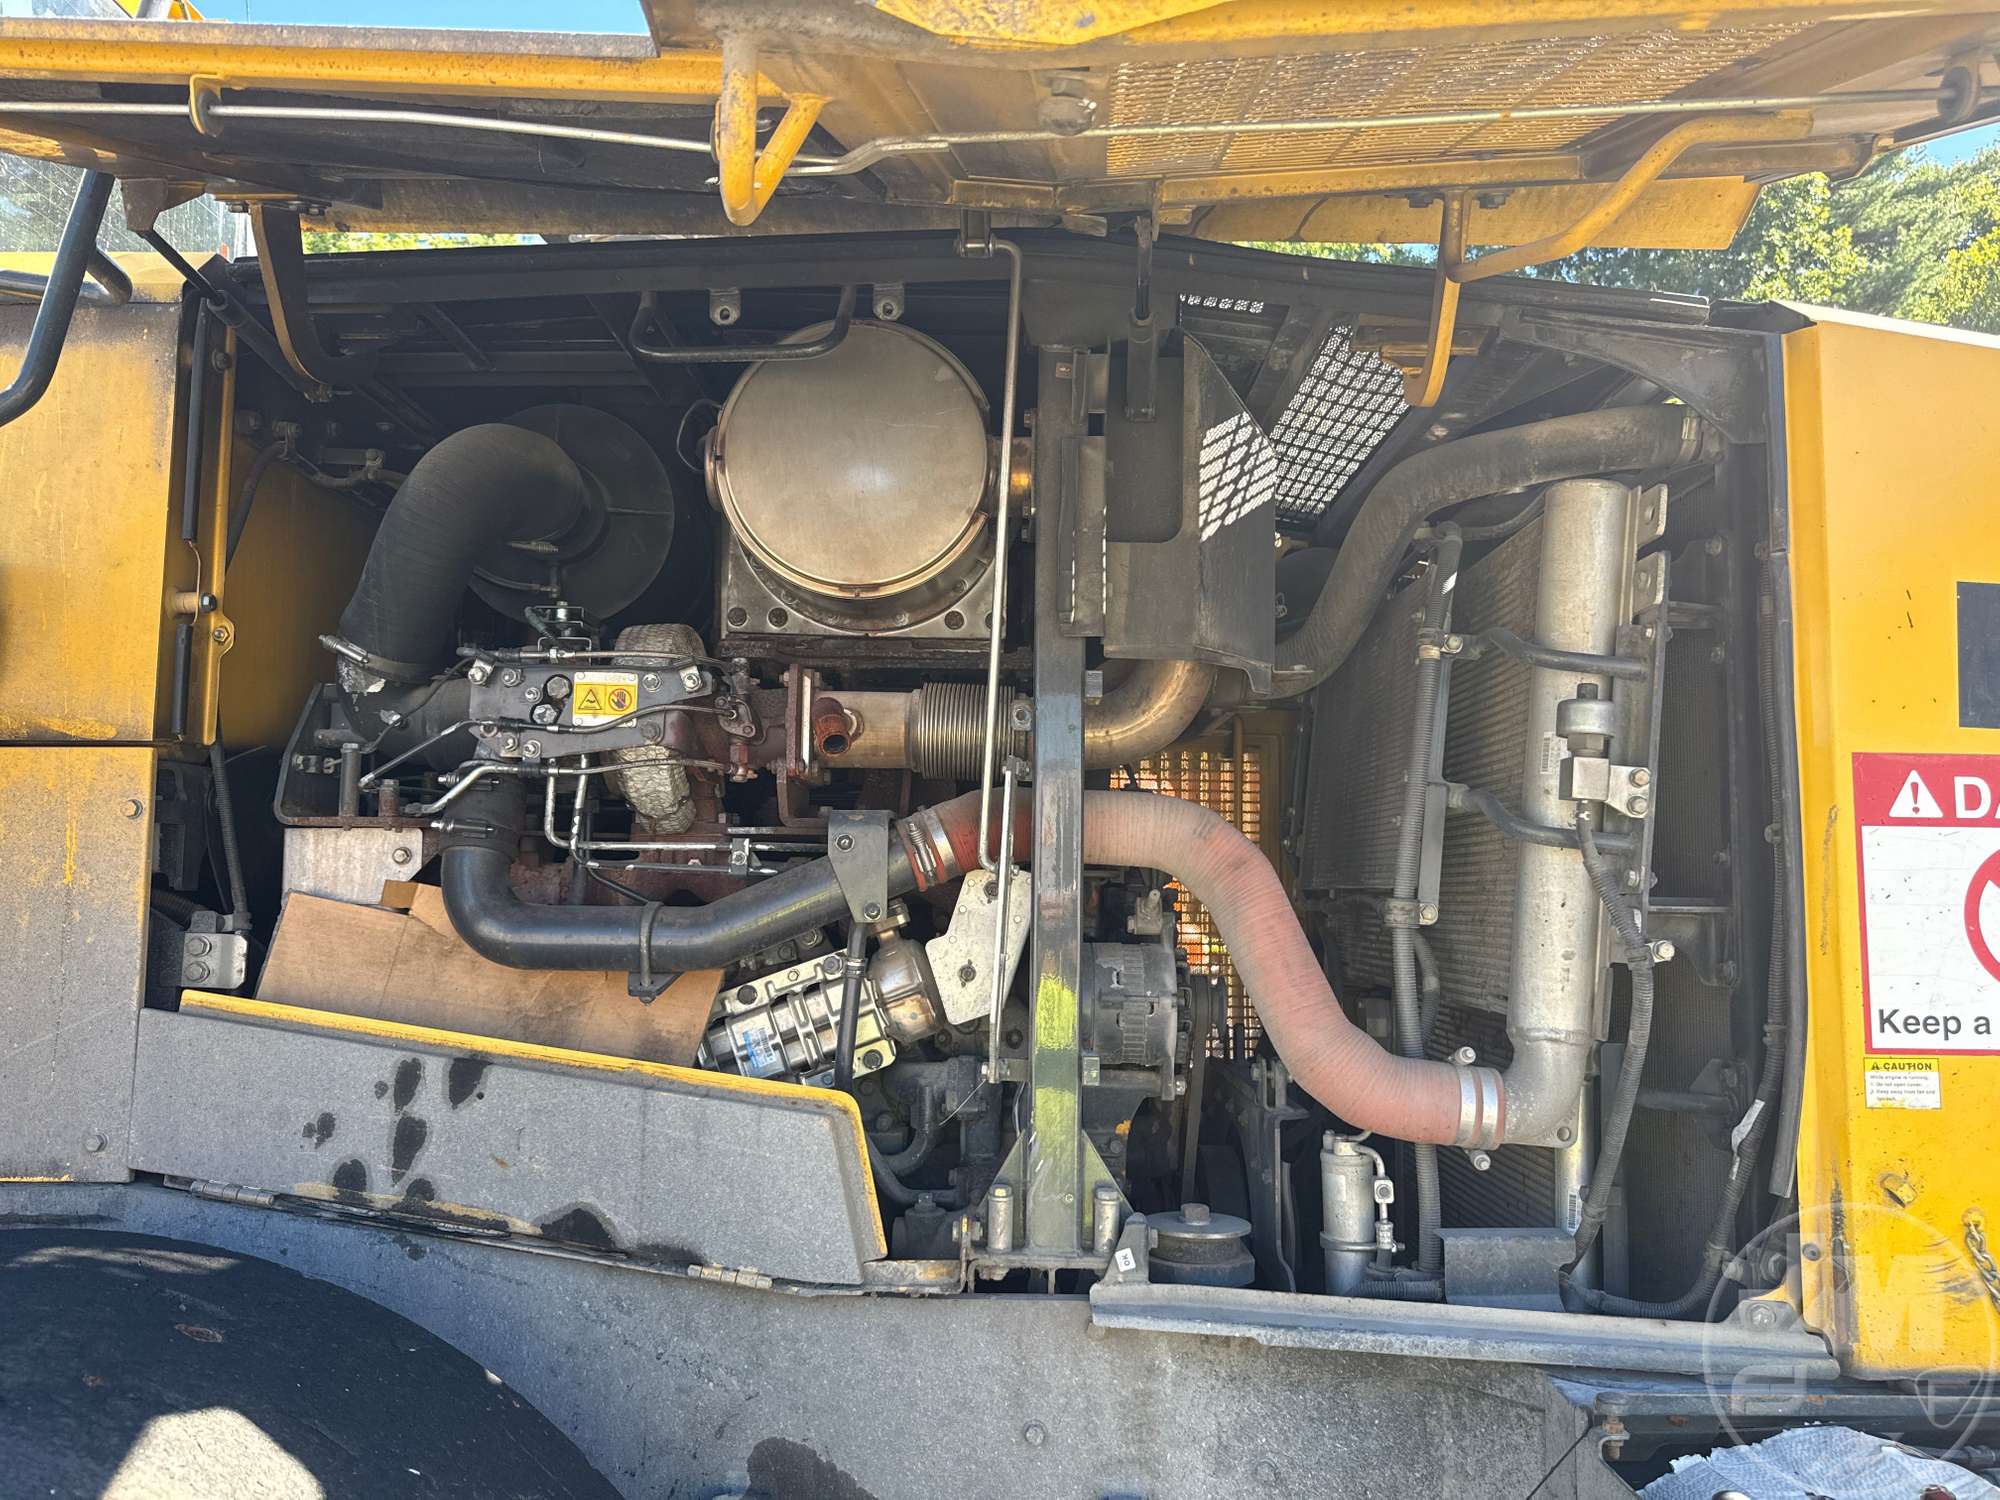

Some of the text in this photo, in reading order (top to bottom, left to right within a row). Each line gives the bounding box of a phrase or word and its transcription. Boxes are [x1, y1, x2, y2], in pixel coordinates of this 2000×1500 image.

[1954, 775, 2000, 819] D
[1878, 1008, 1992, 1041] Keep a
[1883, 1062, 1932, 1071] CAUTION
